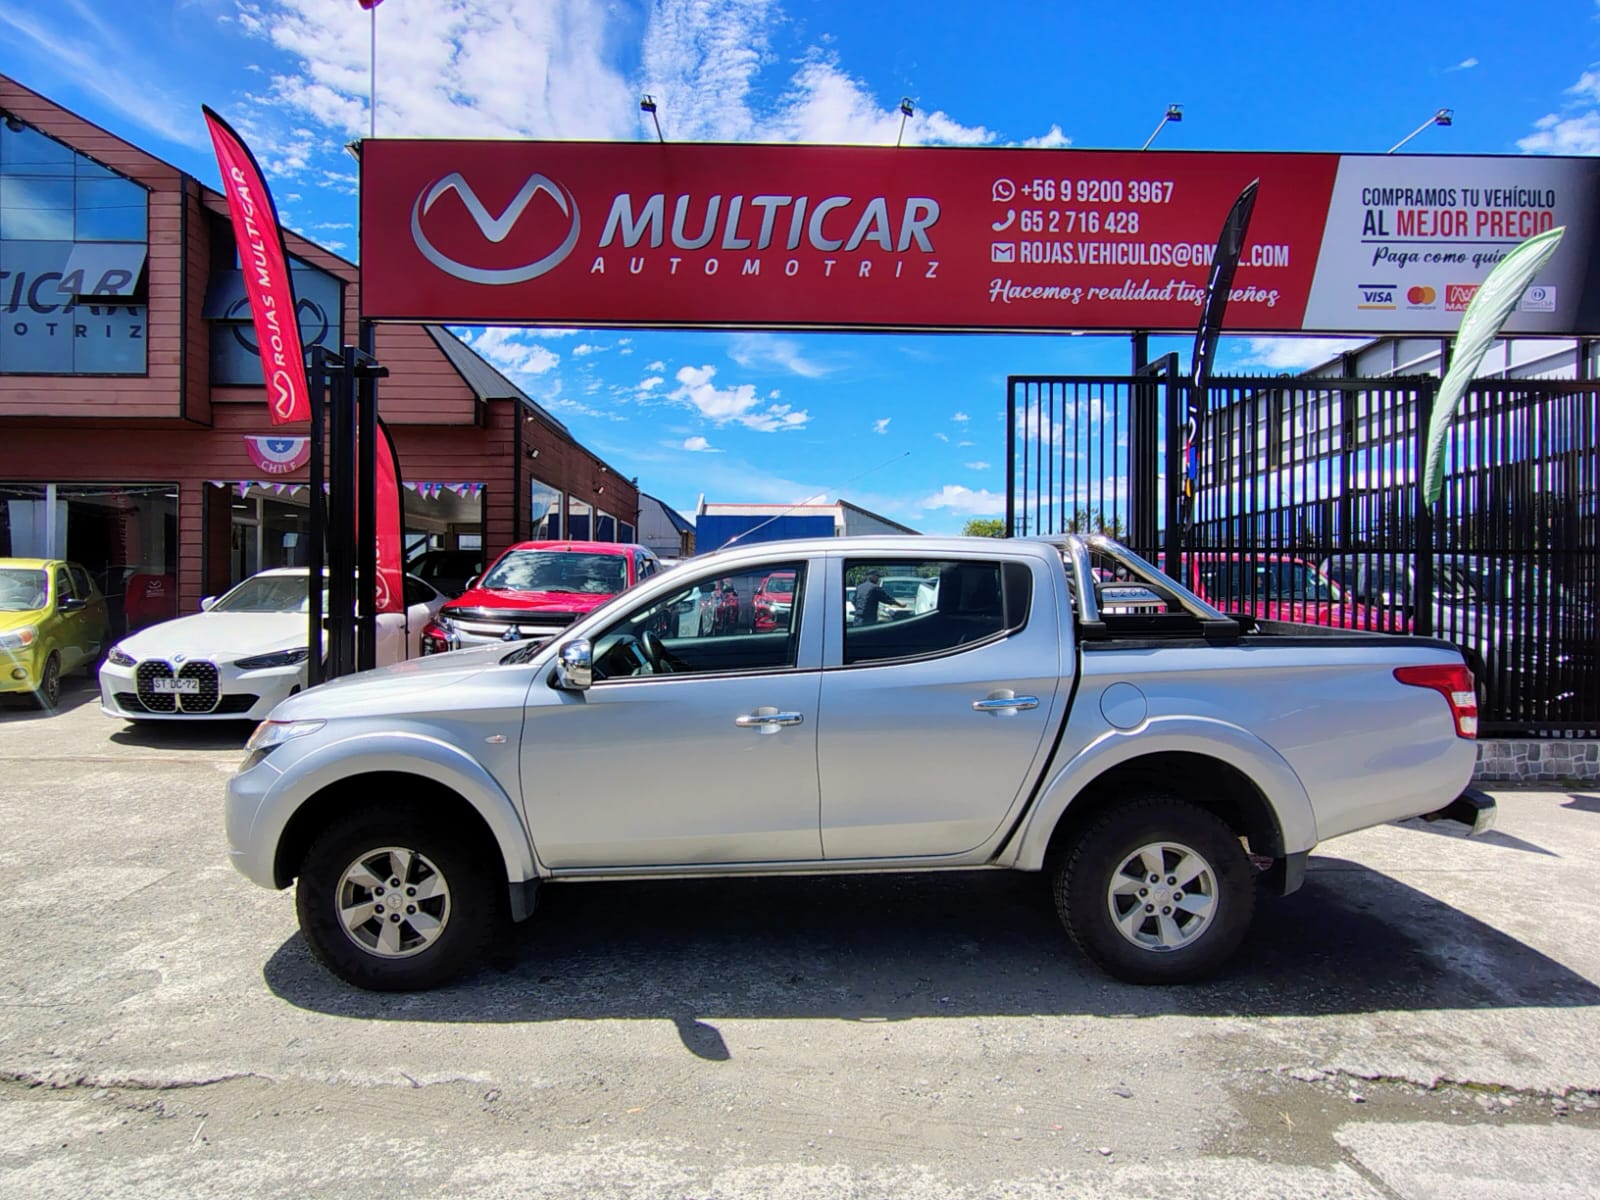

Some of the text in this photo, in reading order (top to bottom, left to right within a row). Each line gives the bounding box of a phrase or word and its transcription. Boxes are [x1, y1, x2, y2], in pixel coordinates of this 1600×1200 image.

[1021, 179, 1175, 203] +56 9 9200 3967
[1362, 185, 1556, 208] COMPRAMOS TU VEHÍCULO
[598, 193, 941, 253] MULTICAR
[1020, 210, 1139, 234] 65 2 716 428
[1363, 209, 1553, 237] AL MEJOR PRECIO
[231, 166, 286, 367] ROJAS MULTICAR
[590, 257, 940, 279] AUTOMOTRIZ
[1372, 246, 1418, 269] Paga
[1423, 250, 1469, 263] como
[989, 278, 1085, 305] Hacemos
[1087, 278, 1174, 301] realidad
[1174, 280, 1206, 307] tus
[1362, 291, 1393, 303] VISA
